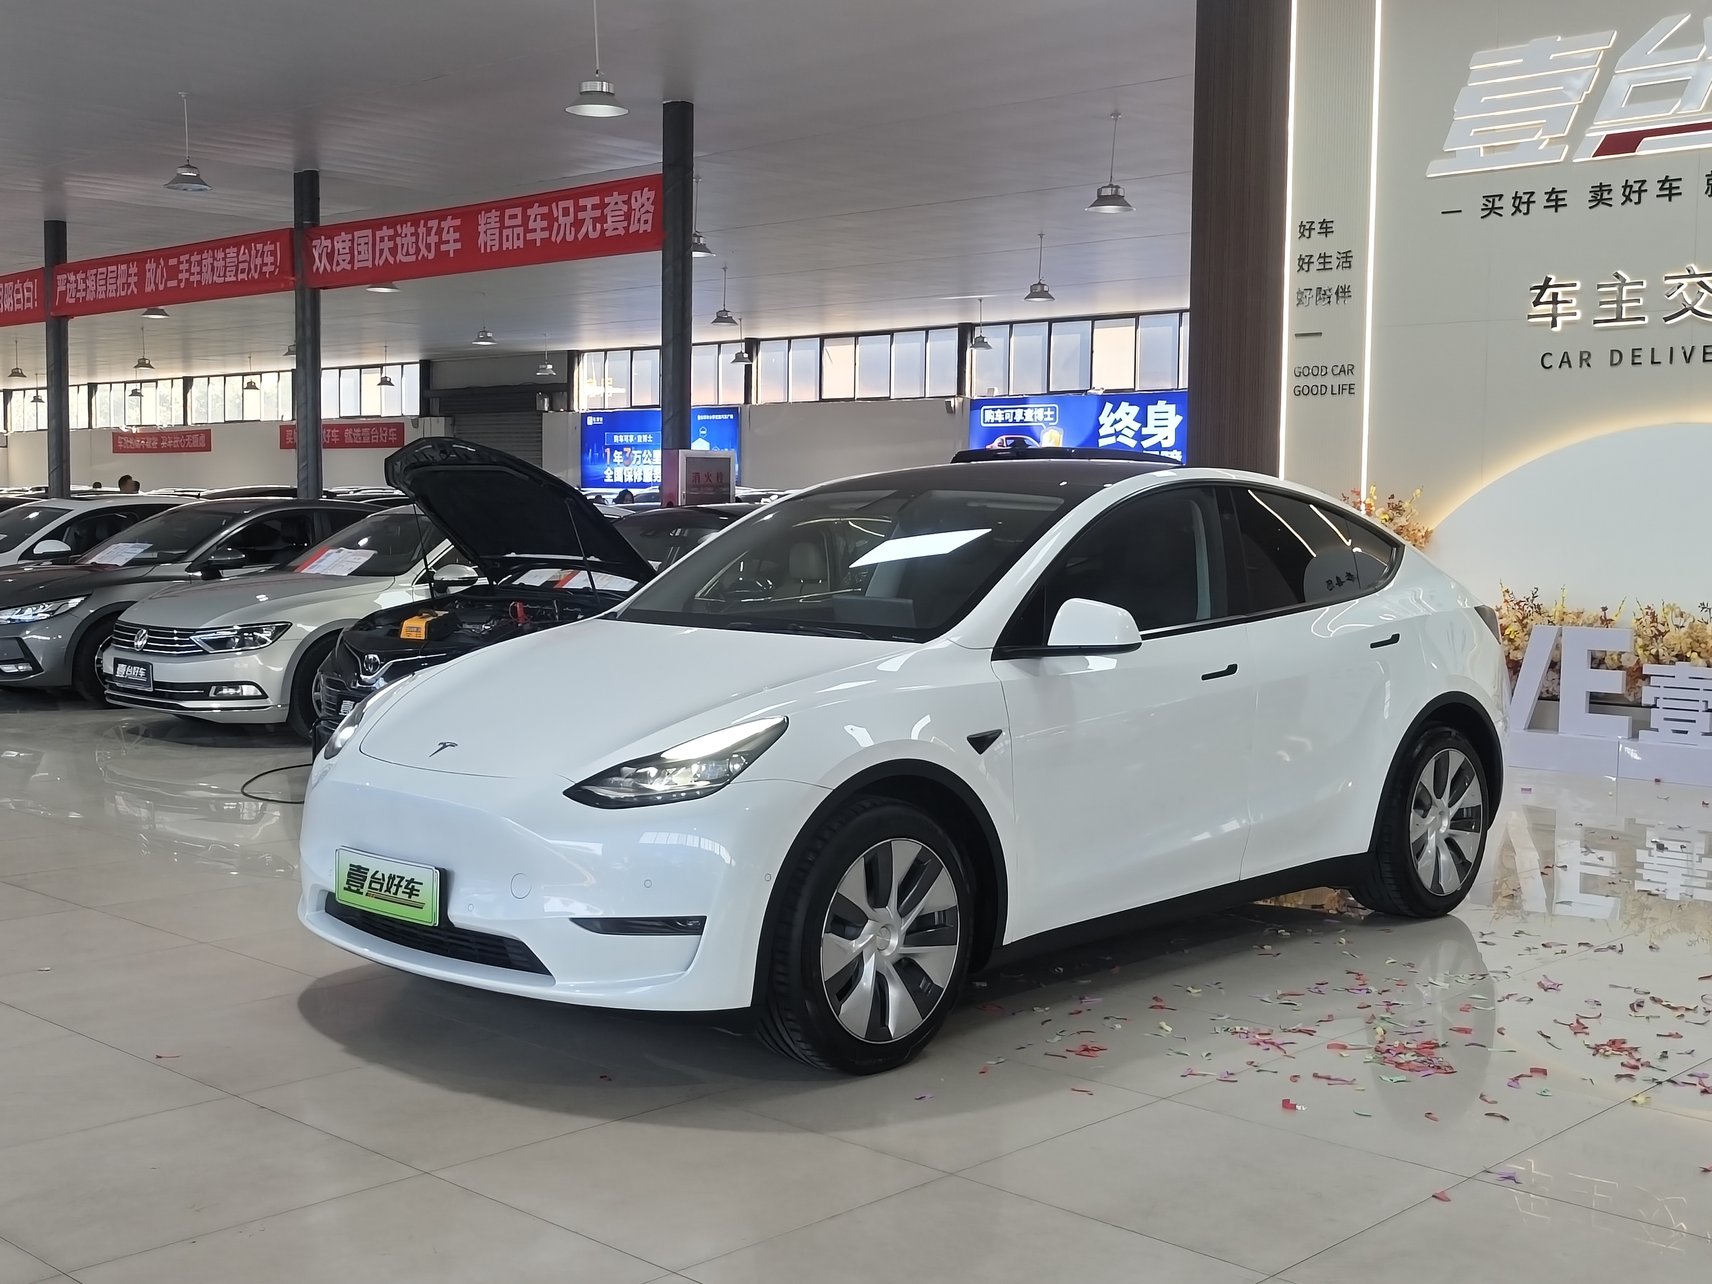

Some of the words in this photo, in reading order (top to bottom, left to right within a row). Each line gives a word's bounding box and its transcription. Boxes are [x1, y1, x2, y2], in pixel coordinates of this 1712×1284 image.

[1480, 187, 1568, 219] 买好车
[1588, 175, 1682, 209] 卖好车
[312, 215, 462, 274] 欢度国庆选好车
[477, 187, 655, 254] 精品车况无套路
[1298, 218, 1335, 240] 好车
[1297, 250, 1353, 273] 好生活
[56, 261, 138, 306] 严选车源层层把关
[1527, 265, 1712, 332] 车主交
[1294, 365, 1328, 378] GOOD
[1331, 364, 1355, 376] CAR
[1540, 350, 1592, 370] CAR
[1293, 384, 1328, 396] GOOD
[1330, 383, 1356, 395] LIFE
[1098, 400, 1183, 449] 终身
[343, 863, 424, 899] 壹台好车
